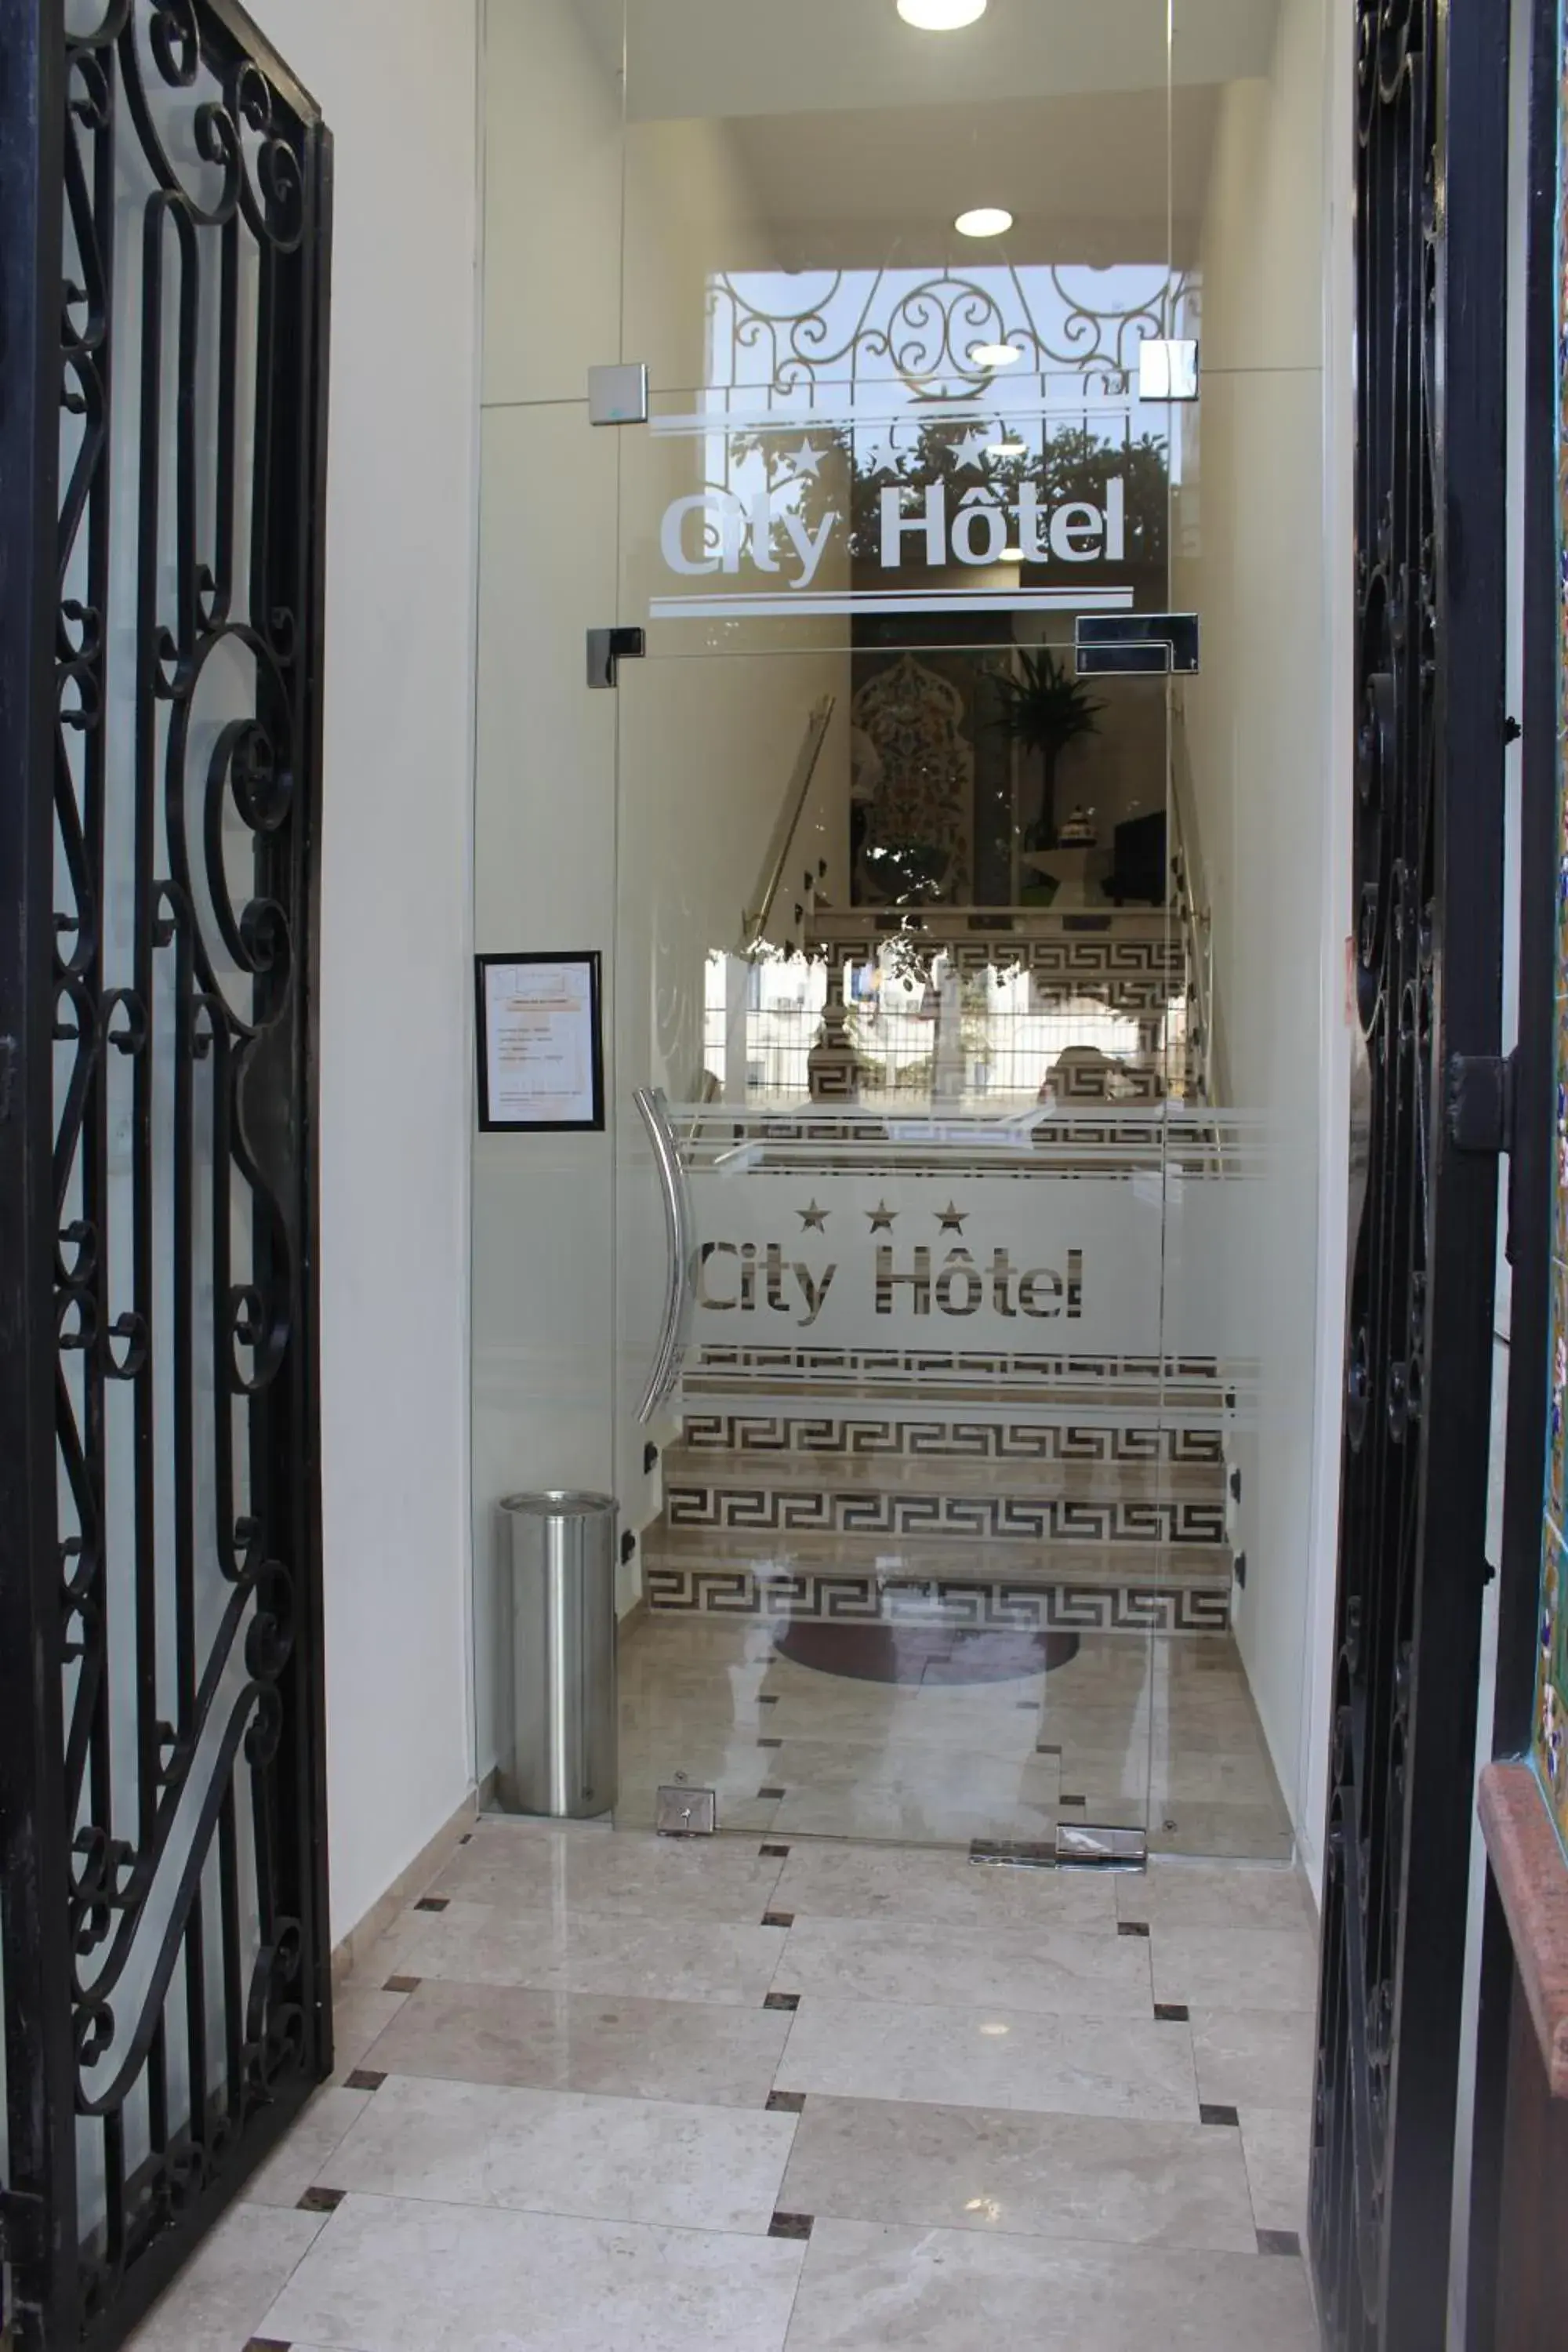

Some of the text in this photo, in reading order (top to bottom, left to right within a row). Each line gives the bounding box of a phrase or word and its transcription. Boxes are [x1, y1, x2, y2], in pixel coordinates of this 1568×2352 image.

[660, 477, 1124, 589] City Hôtel
[695, 1241, 1083, 1327] City Hôtel
